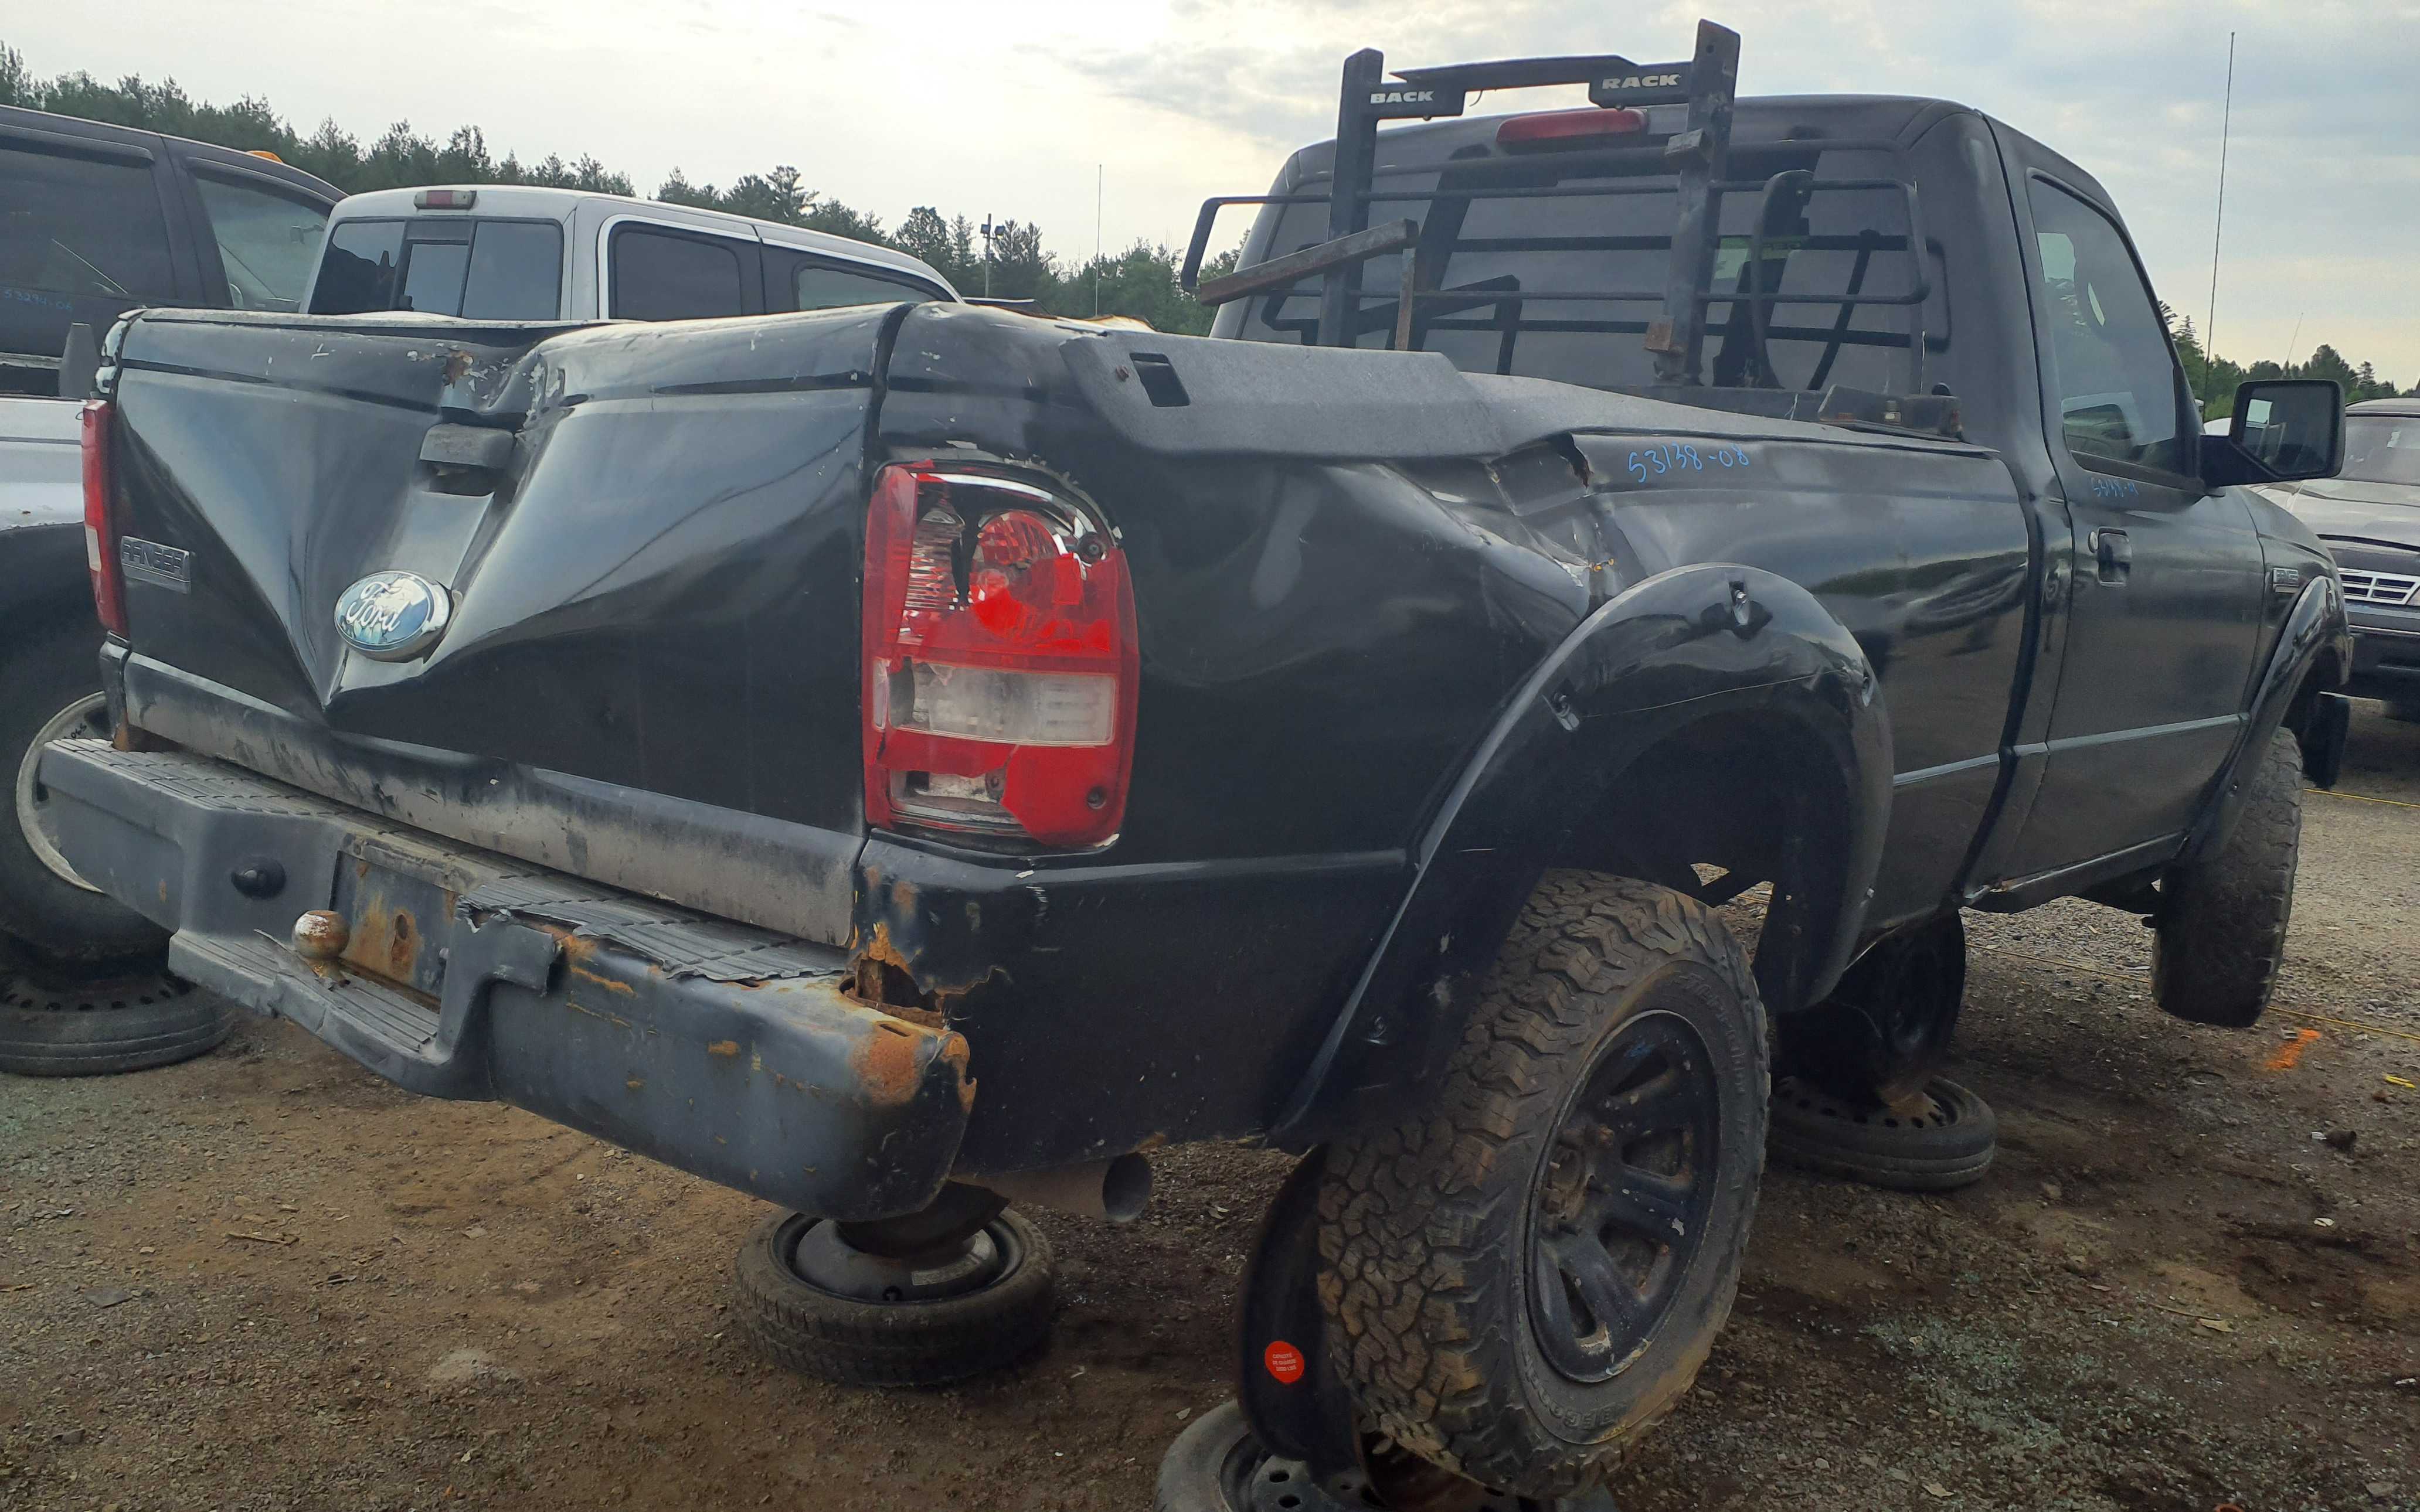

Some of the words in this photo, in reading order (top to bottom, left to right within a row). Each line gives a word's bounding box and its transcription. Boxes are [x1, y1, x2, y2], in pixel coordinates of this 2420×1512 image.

[1370, 90, 1435, 104] BACK
[1602, 74, 1680, 90] RACK
[1627, 441, 1749, 483] 53138-08
[121, 539, 184, 577] RANGER
[346, 581, 411, 632] Ford
